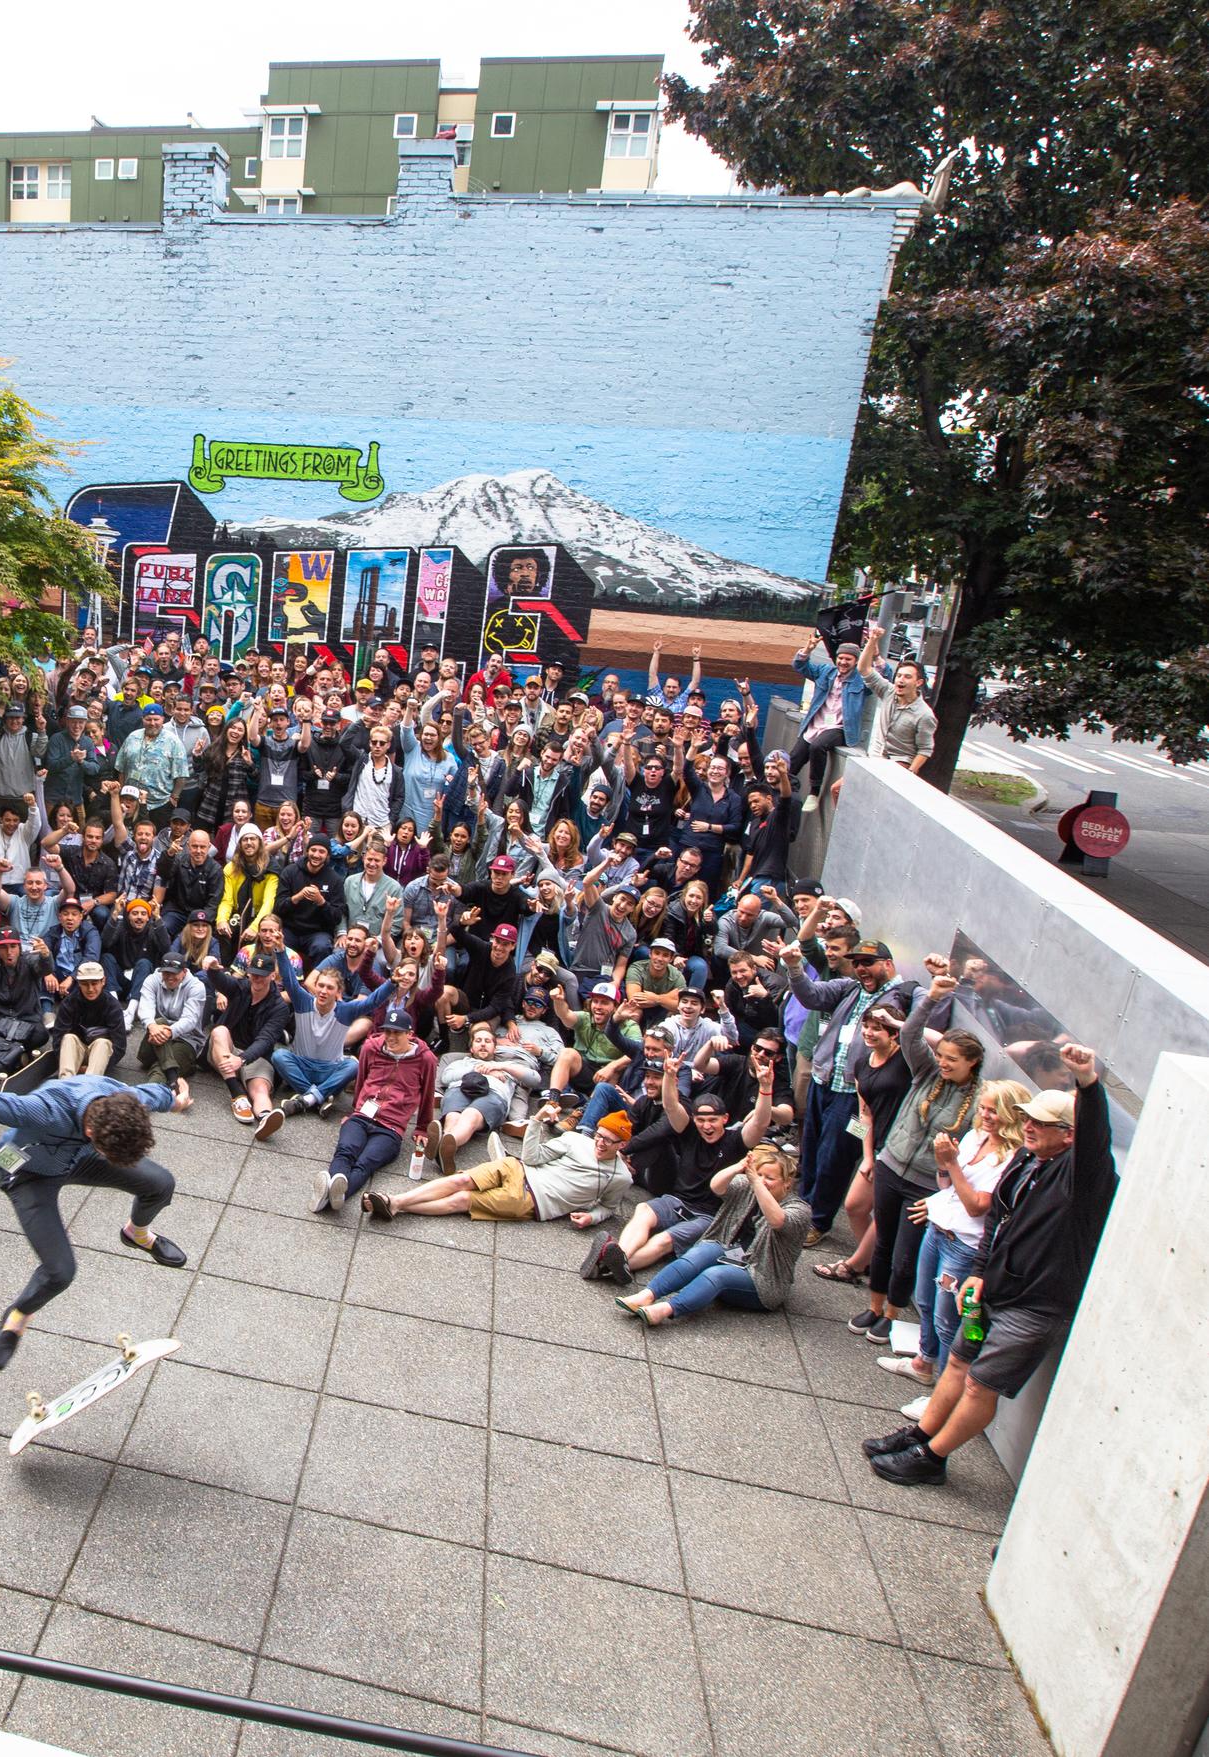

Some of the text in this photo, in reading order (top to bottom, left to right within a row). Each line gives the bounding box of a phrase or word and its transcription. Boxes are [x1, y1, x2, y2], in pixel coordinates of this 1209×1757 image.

[214, 447, 352, 477] GREETINGS FROM
[299, 553, 333, 581] W
[424, 587, 448, 602] WA
[1081, 829, 1120, 843] COFFEE
[1082, 821, 1123, 836] BEDLAM
[390, 1013, 397, 1022] S
